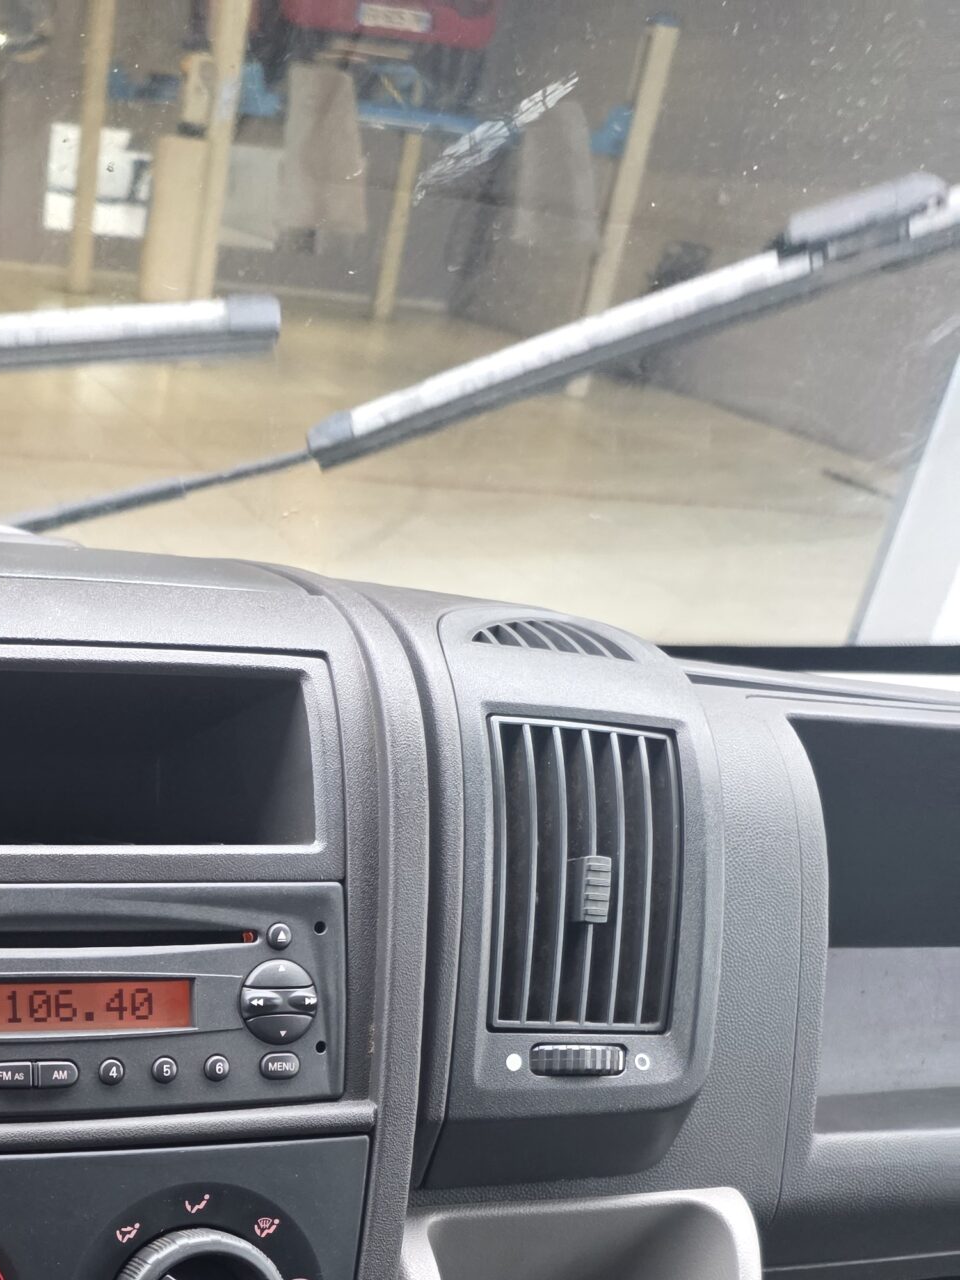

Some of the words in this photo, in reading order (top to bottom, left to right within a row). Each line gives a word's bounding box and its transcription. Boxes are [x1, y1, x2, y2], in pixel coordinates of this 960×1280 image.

[7, 988, 153, 1023] 106.40
[109, 1067, 117, 1079] 4
[162, 1064, 171, 1077] 5
[215, 1063, 224, 1075] 6
[268, 1062, 295, 1073] MENU
[13, 1073, 25, 1081] AS
[52, 1070, 68, 1081] AM
